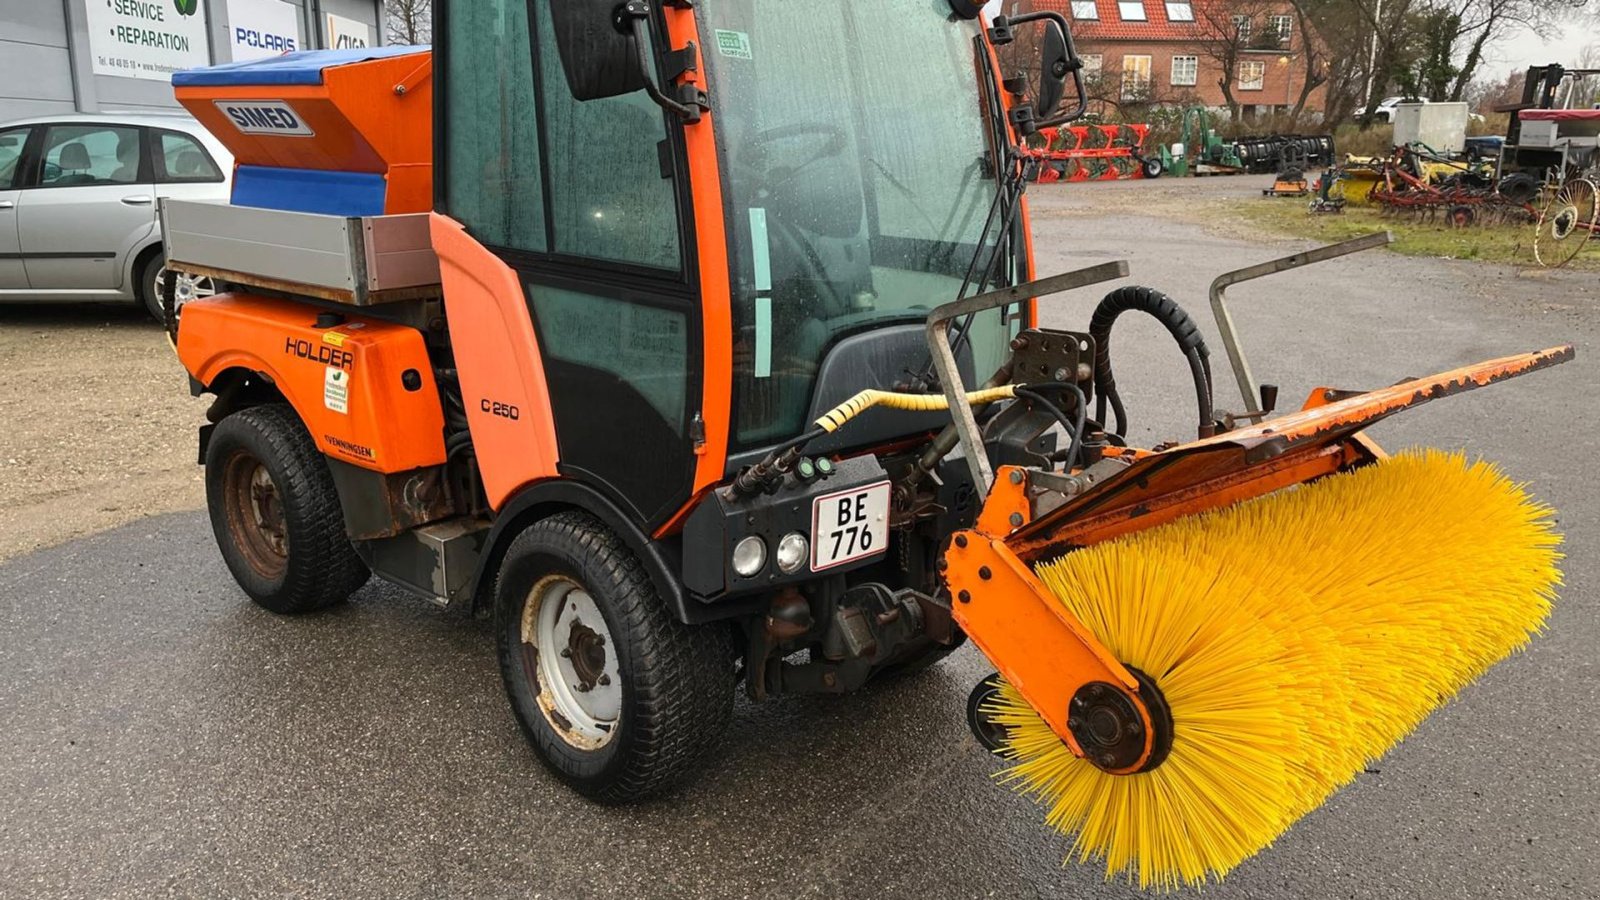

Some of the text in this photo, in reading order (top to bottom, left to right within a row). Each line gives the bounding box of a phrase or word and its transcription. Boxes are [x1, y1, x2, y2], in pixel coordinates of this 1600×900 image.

[114, 0, 164, 22] SERVICE
[117, 25, 189, 52] REPARATION
[236, 27, 296, 52] POLARIS
[226, 107, 299, 129] SIMED
[285, 336, 354, 370] HOLDER
[481, 398, 519, 421] C 250
[838, 493, 868, 527] BE
[831, 523, 872, 560] 776
